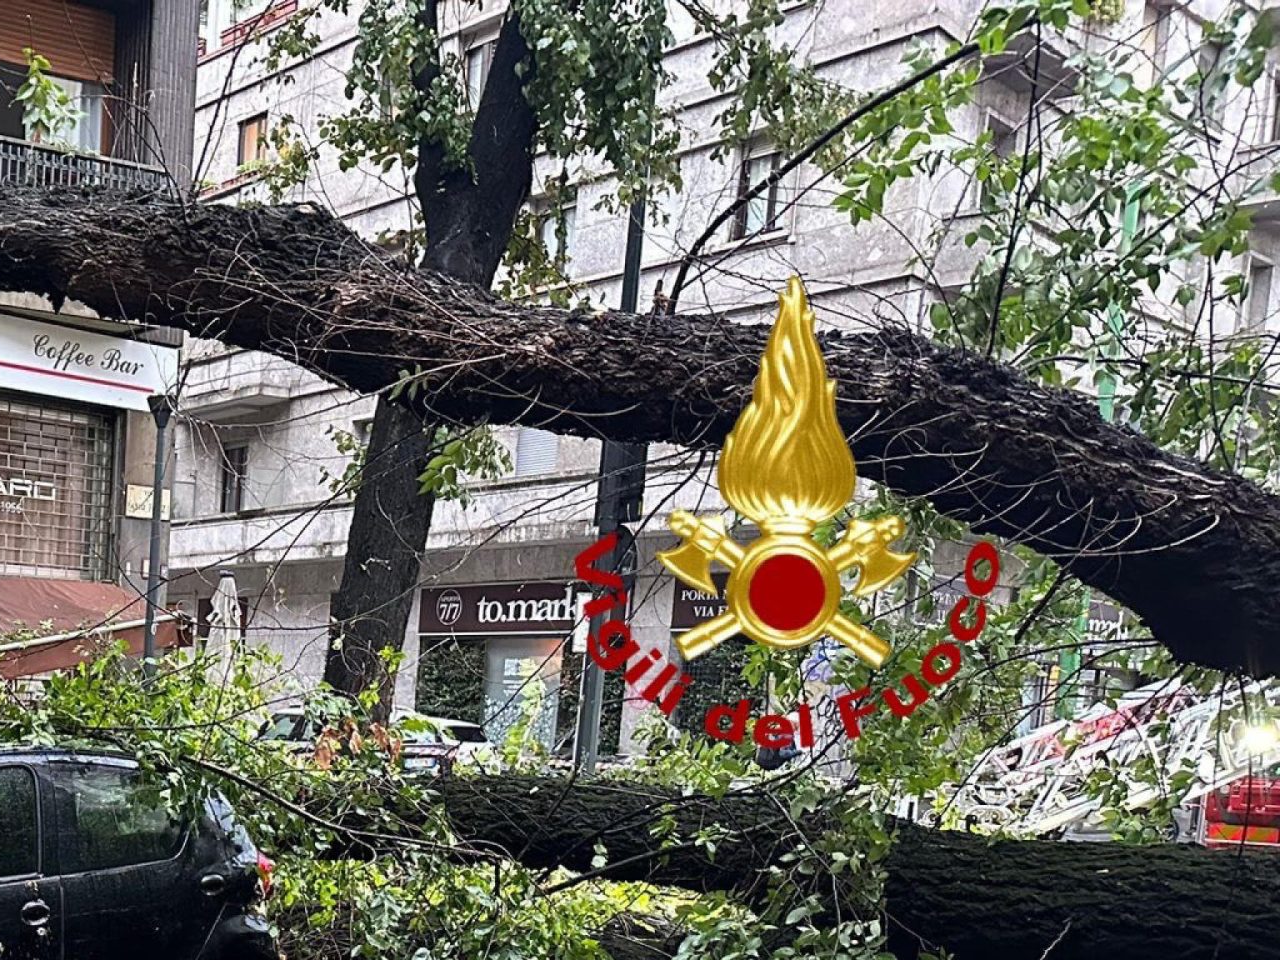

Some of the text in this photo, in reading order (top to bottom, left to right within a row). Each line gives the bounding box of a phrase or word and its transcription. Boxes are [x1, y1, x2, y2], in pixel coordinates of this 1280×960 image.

[33, 334, 144, 375] Coffee Bar
[693, 605, 715, 617] VIA
